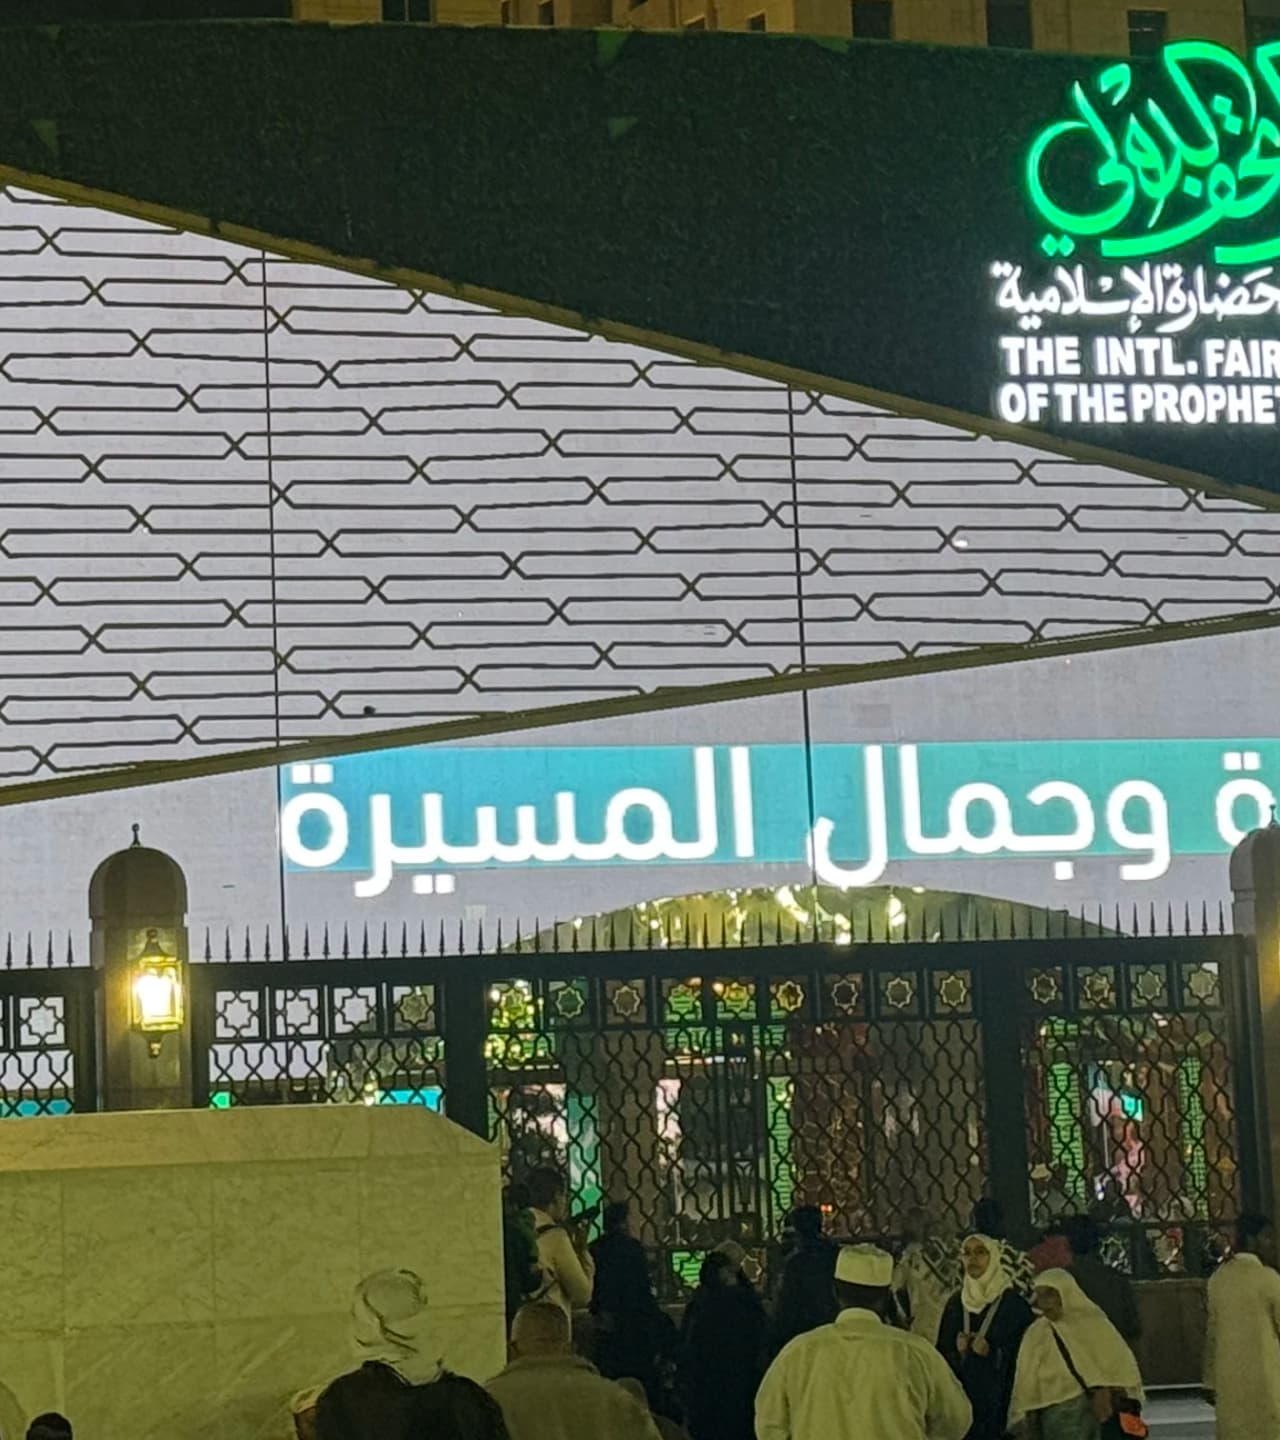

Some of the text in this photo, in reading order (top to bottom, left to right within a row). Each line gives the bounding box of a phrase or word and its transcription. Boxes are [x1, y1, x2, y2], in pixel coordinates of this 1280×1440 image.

[999, 336, 1082, 376] THE
[1095, 337, 1199, 377] INTL.
[999, 382, 1048, 424] OF
[1053, 383, 1127, 423] THE
[281, 745, 754, 898] المسيرة
[806, 744, 1171, 887] وجمال
